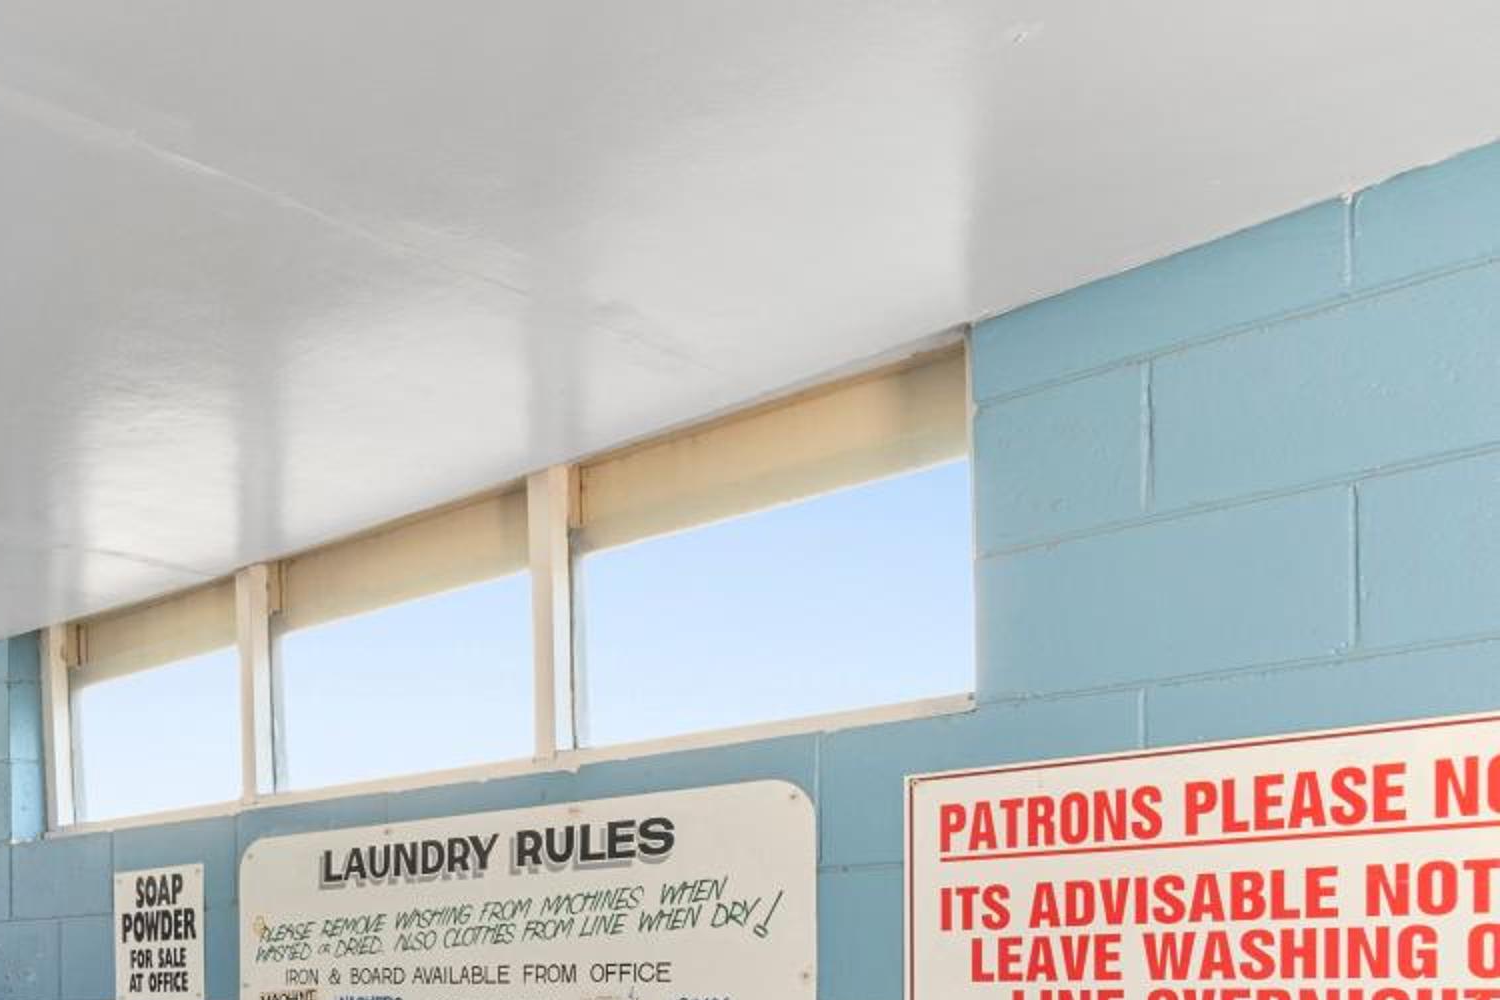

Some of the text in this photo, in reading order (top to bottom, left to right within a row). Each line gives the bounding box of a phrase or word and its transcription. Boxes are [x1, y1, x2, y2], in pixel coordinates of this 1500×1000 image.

[939, 785, 1163, 853] PATRONS
[1184, 762, 1408, 836] PLEASE
[321, 817, 675, 887] LAUNDRY RULES
[135, 874, 184, 908] SOAP
[260, 876, 728, 942] PLEASE REMOVE WASHING FROM MACHINES WHEN
[940, 858, 1500, 931] ITS ADVISABLE NOT
[121, 908, 197, 944] POWDER
[394, 931, 438, 951] ALSO
[444, 923, 516, 950] CLOTHES
[522, 917, 575, 942] FROM
[580, 913, 629, 938] LINE
[638, 905, 703, 932] WHEN
[129, 947, 187, 969] FOR SALE
[285, 962, 673, 985] IRON & BOARD AVAILABLE FROM OFFICE
[971, 933, 1122, 982] LEAVE
[1143, 924, 1438, 981] WASHING
[128, 971, 189, 993] AT OFFICE
